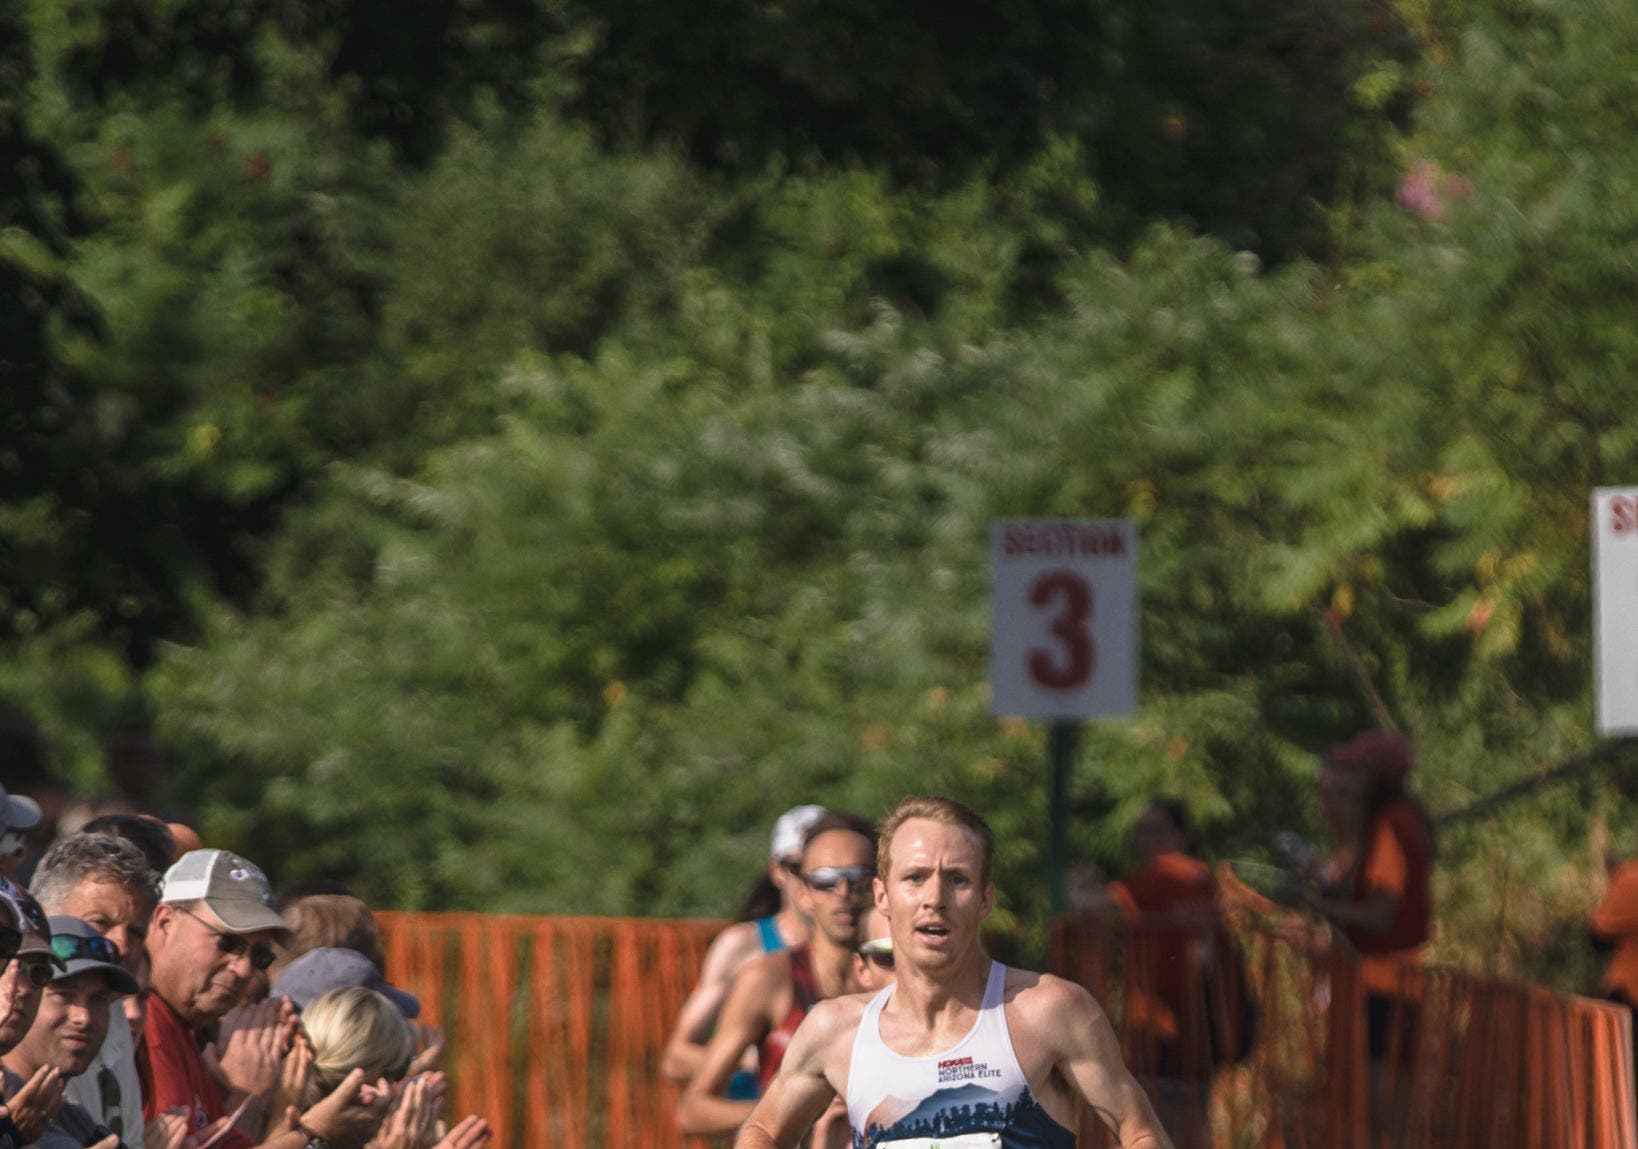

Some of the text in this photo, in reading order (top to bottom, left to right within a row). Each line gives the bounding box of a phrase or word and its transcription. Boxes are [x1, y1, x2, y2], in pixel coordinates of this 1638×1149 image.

[1611, 495, 1638, 536] S
[1004, 523, 1127, 556] SECTION
[1028, 568, 1095, 692] 3
[938, 1063, 988, 1075] NORTHERN
[938, 1069, 1002, 1083] ARIZONA ELITE
